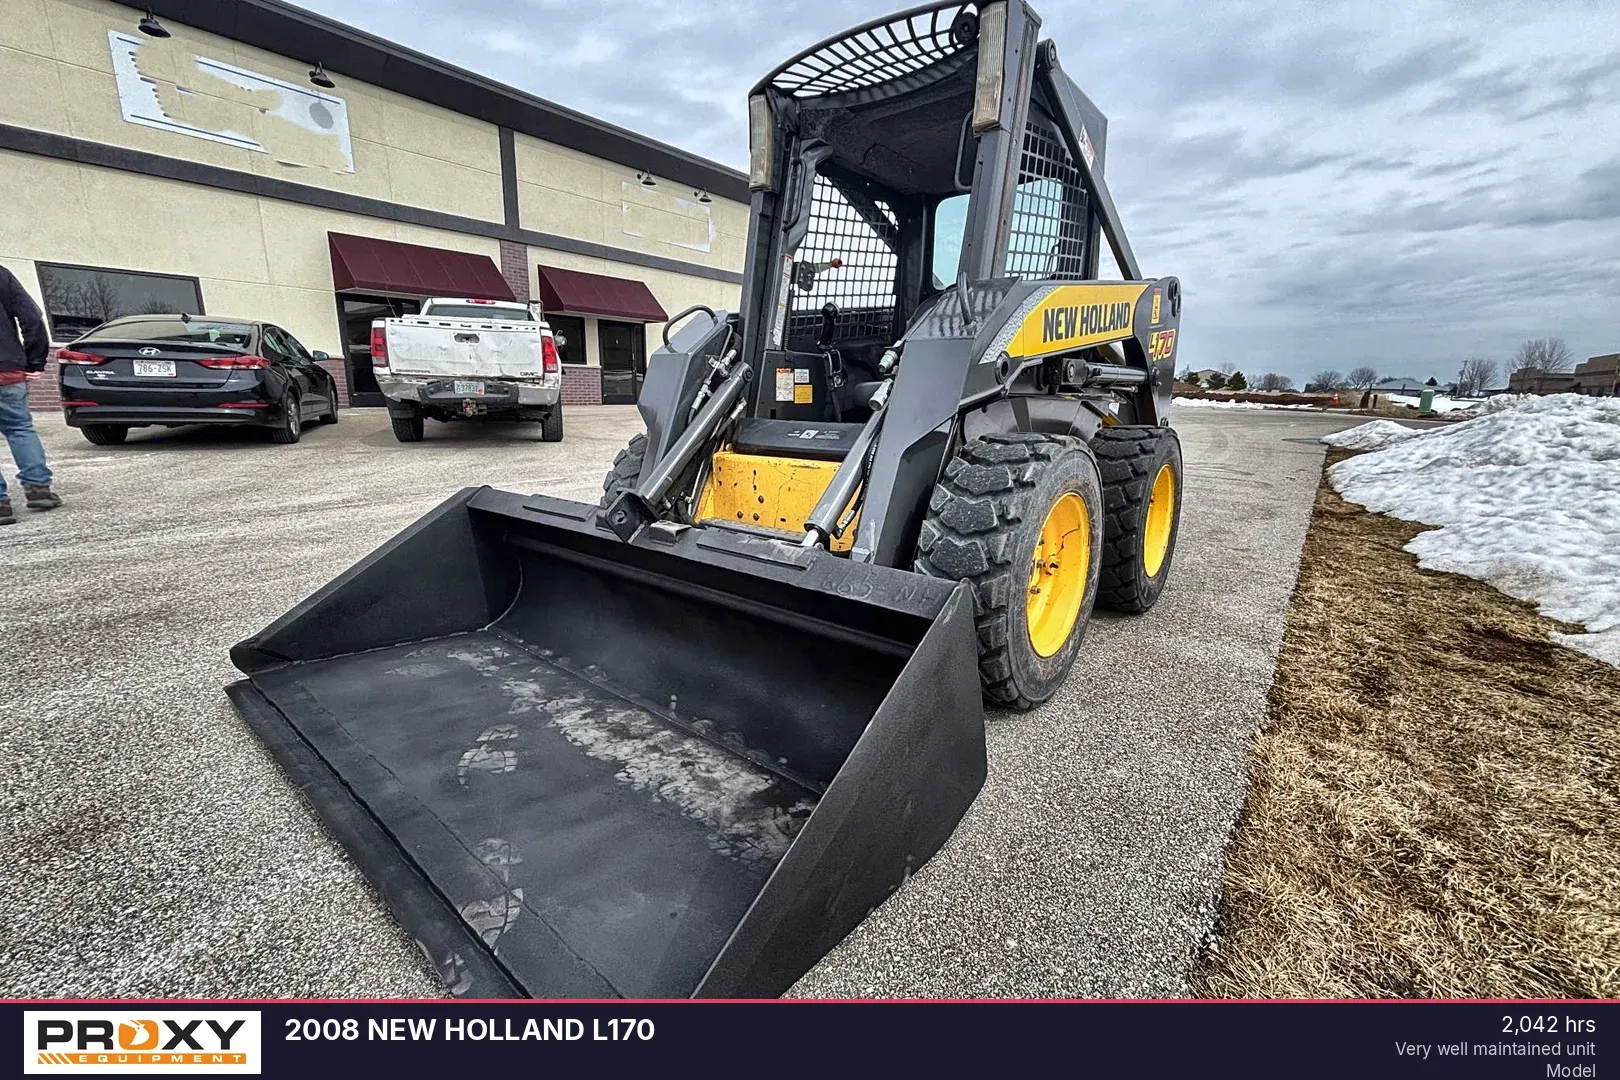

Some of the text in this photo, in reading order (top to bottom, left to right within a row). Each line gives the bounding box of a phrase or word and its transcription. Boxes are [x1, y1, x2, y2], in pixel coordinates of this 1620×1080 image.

[1043, 307, 1078, 343] NEW
[1080, 302, 1131, 336] HOLLAND
[137, 363, 172, 373] 786-ZSK
